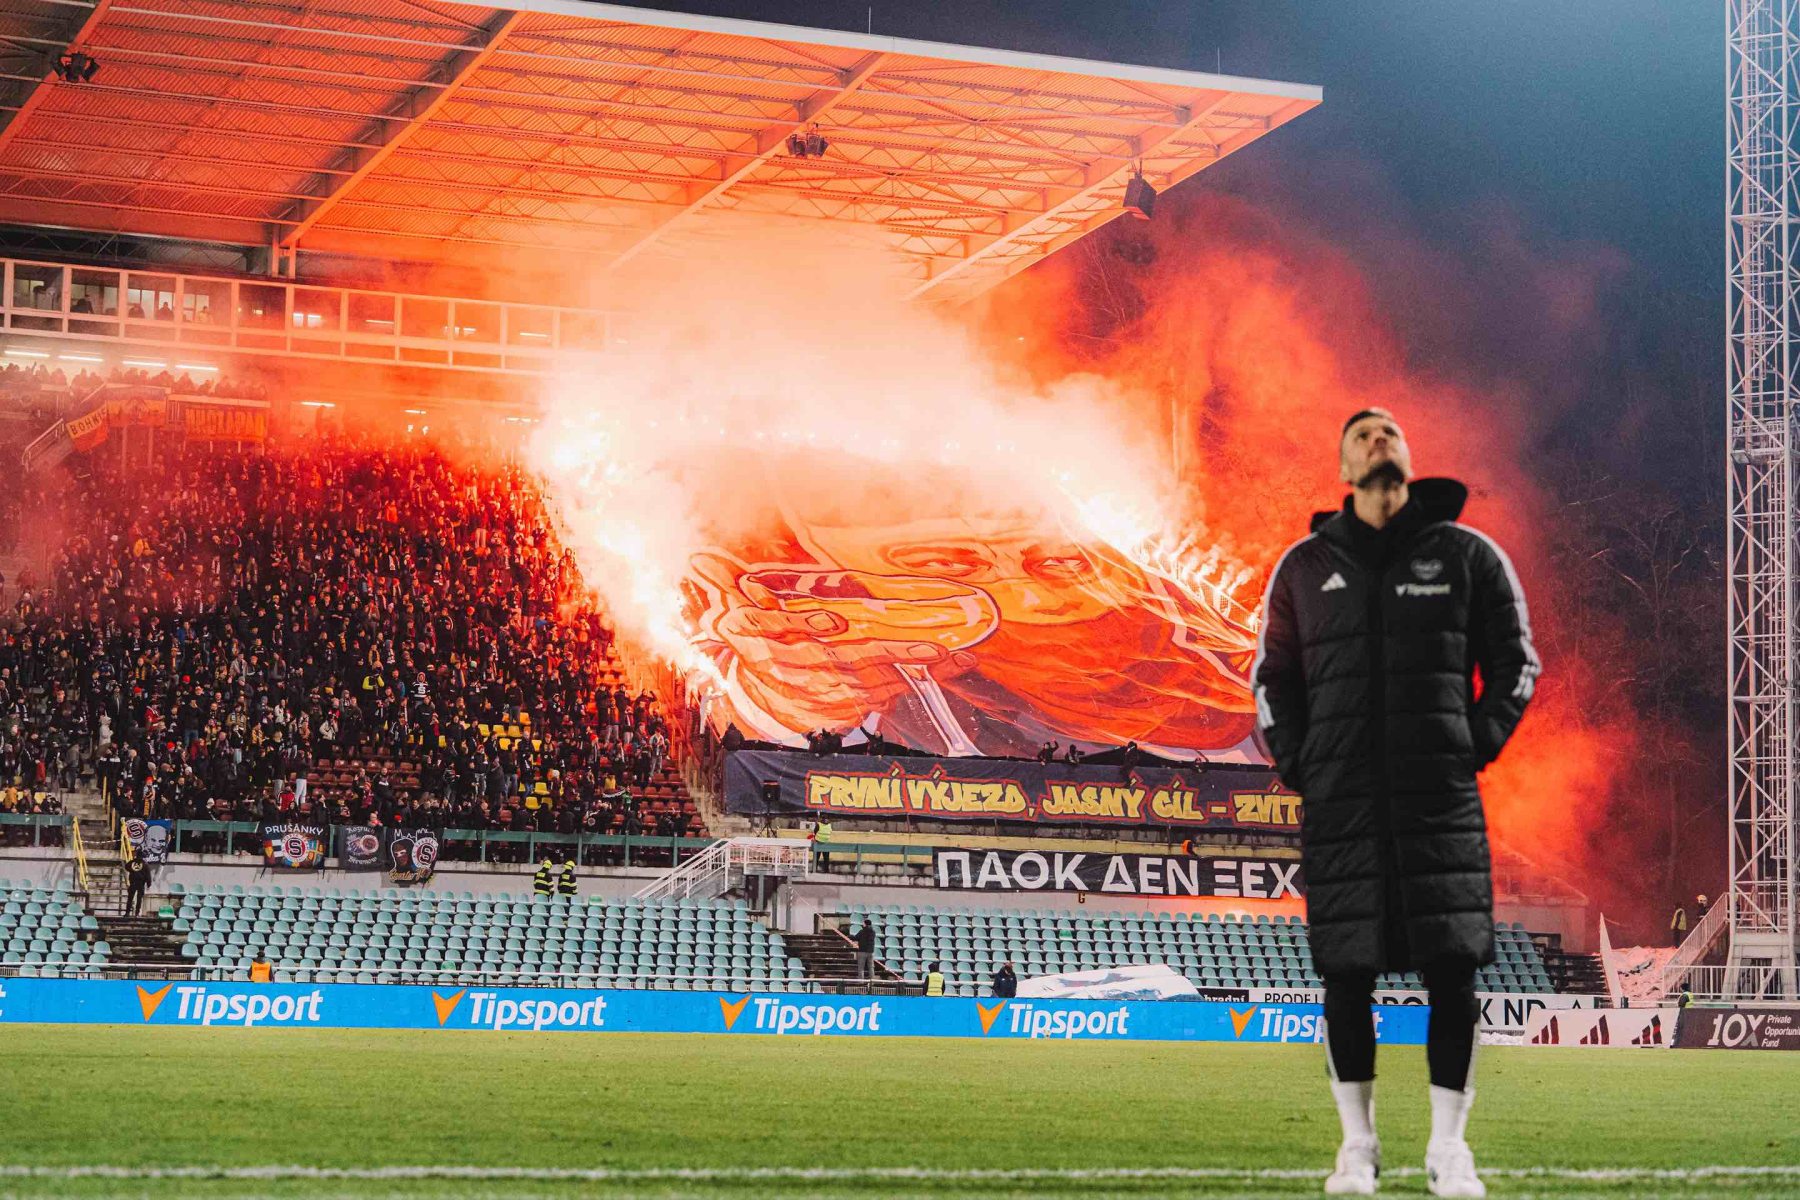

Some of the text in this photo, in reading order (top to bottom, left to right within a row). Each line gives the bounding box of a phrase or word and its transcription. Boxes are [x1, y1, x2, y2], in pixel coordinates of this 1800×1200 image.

[810, 768, 903, 808] PRVNÍ
[1042, 778, 1146, 818] JASNÝ
[1152, 780, 1204, 820] CÍL
[937, 850, 1090, 891] ΠΑΟΚ
[1101, 854, 1199, 896] ΔΕΝ
[177, 986, 323, 1026] Tipsport
[469, 992, 607, 1030] Tipsport
[754, 997, 882, 1035] Tipsport
[1009, 1003, 1130, 1039] Tipsport
[1767, 1014, 1792, 1024] Private
[1706, 1013, 1766, 1047] 10X
[1761, 1038, 1780, 1048] Fund
